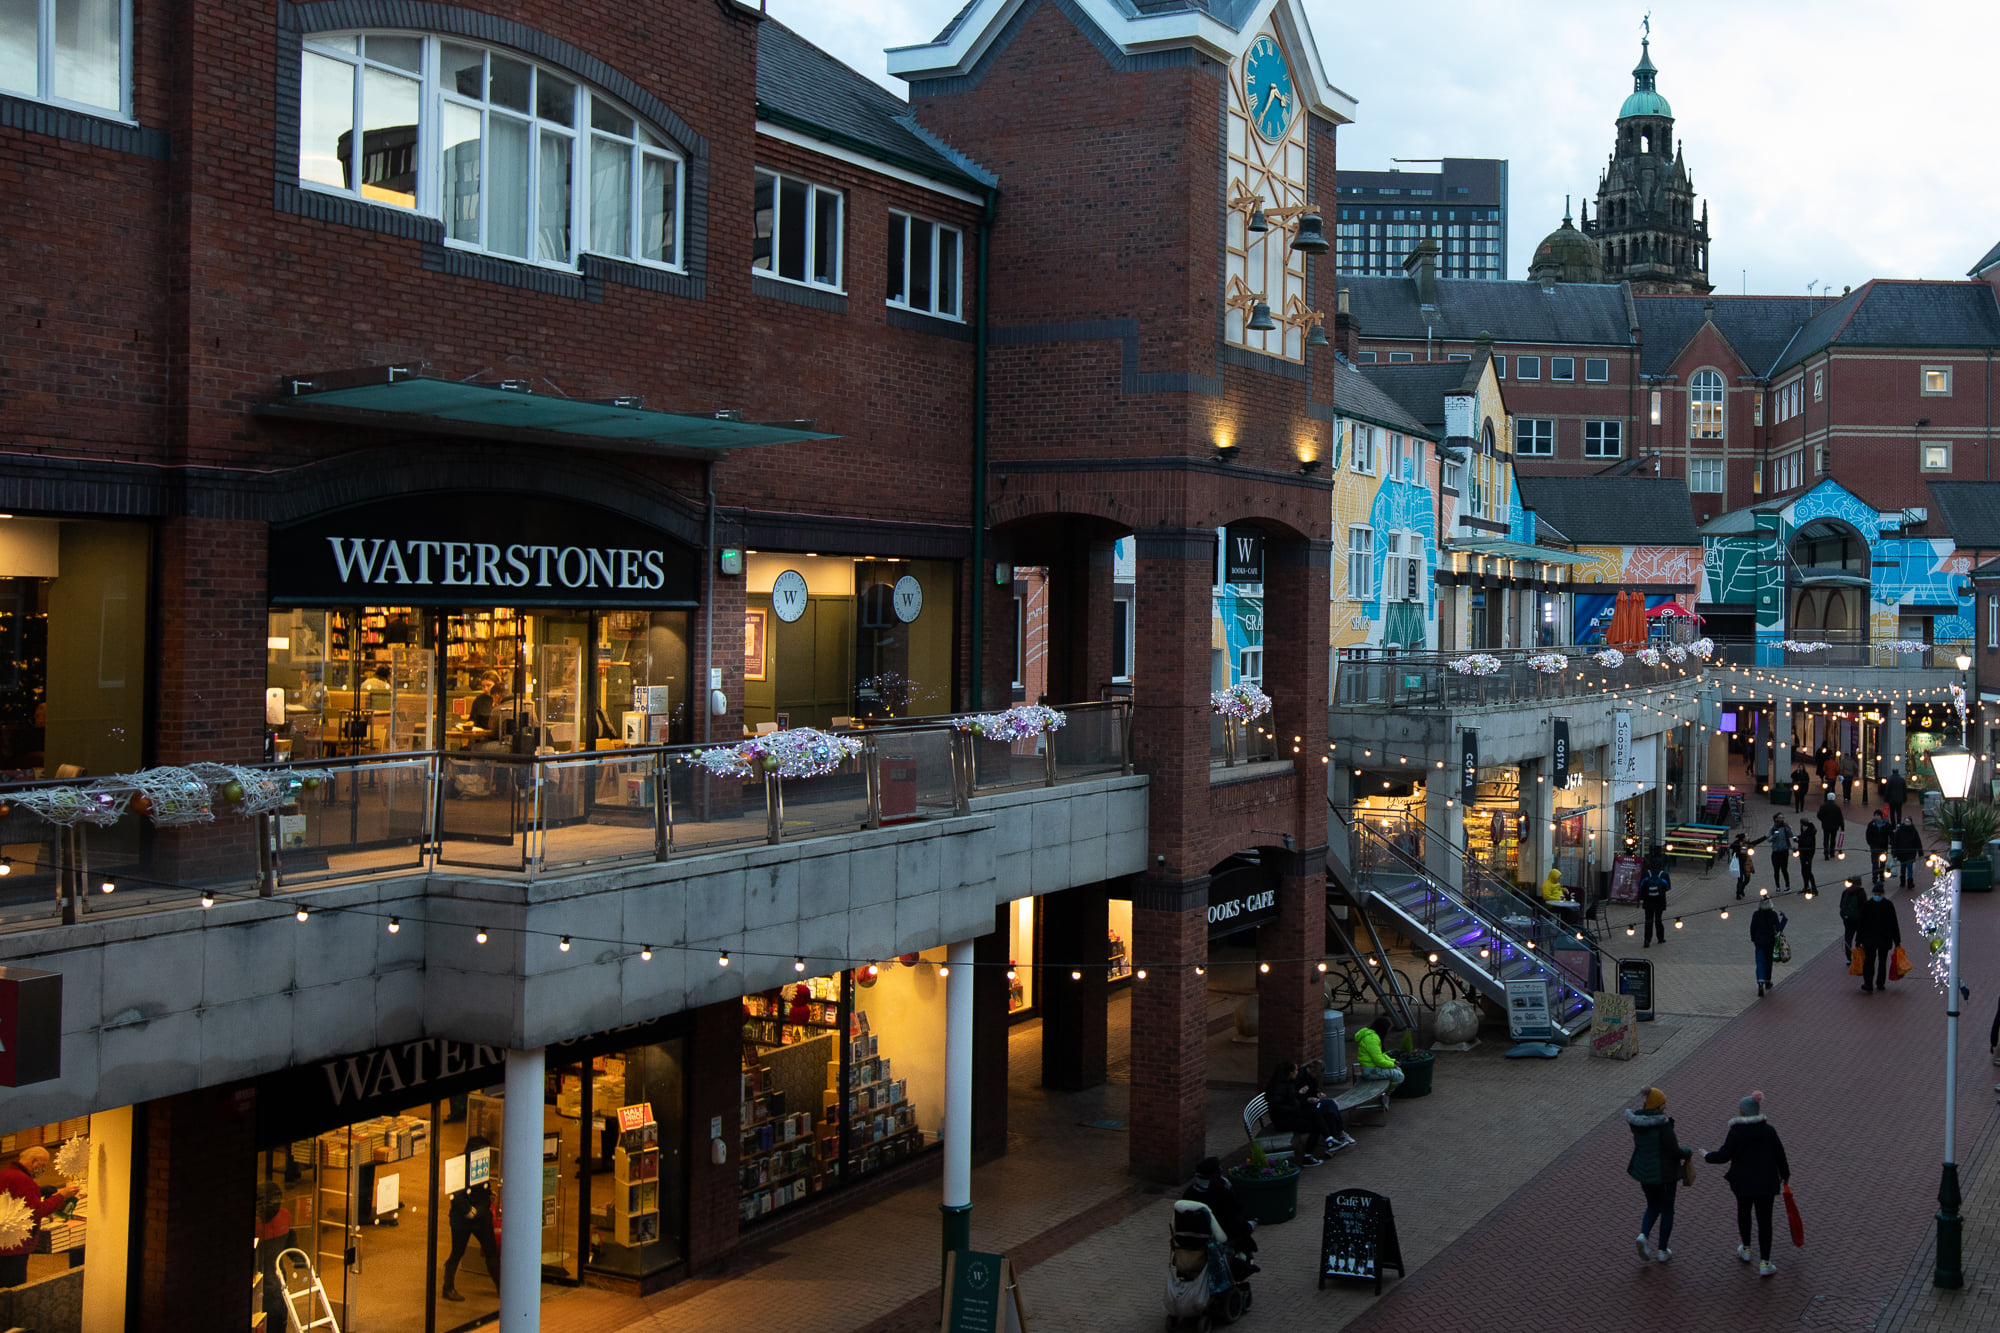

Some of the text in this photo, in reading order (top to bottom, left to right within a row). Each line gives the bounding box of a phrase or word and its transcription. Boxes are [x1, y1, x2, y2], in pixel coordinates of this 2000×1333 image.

[1236, 537, 1254, 563] W
[325, 536, 665, 590] WATERSTONES
[783, 590, 798, 605] W
[902, 593, 914, 607] W
[1556, 739, 1565, 770] COSTA
[1208, 889, 1275, 924] OOKS CAFE
[1360, 1197, 1372, 1207] W
[973, 1271, 984, 1281] W
